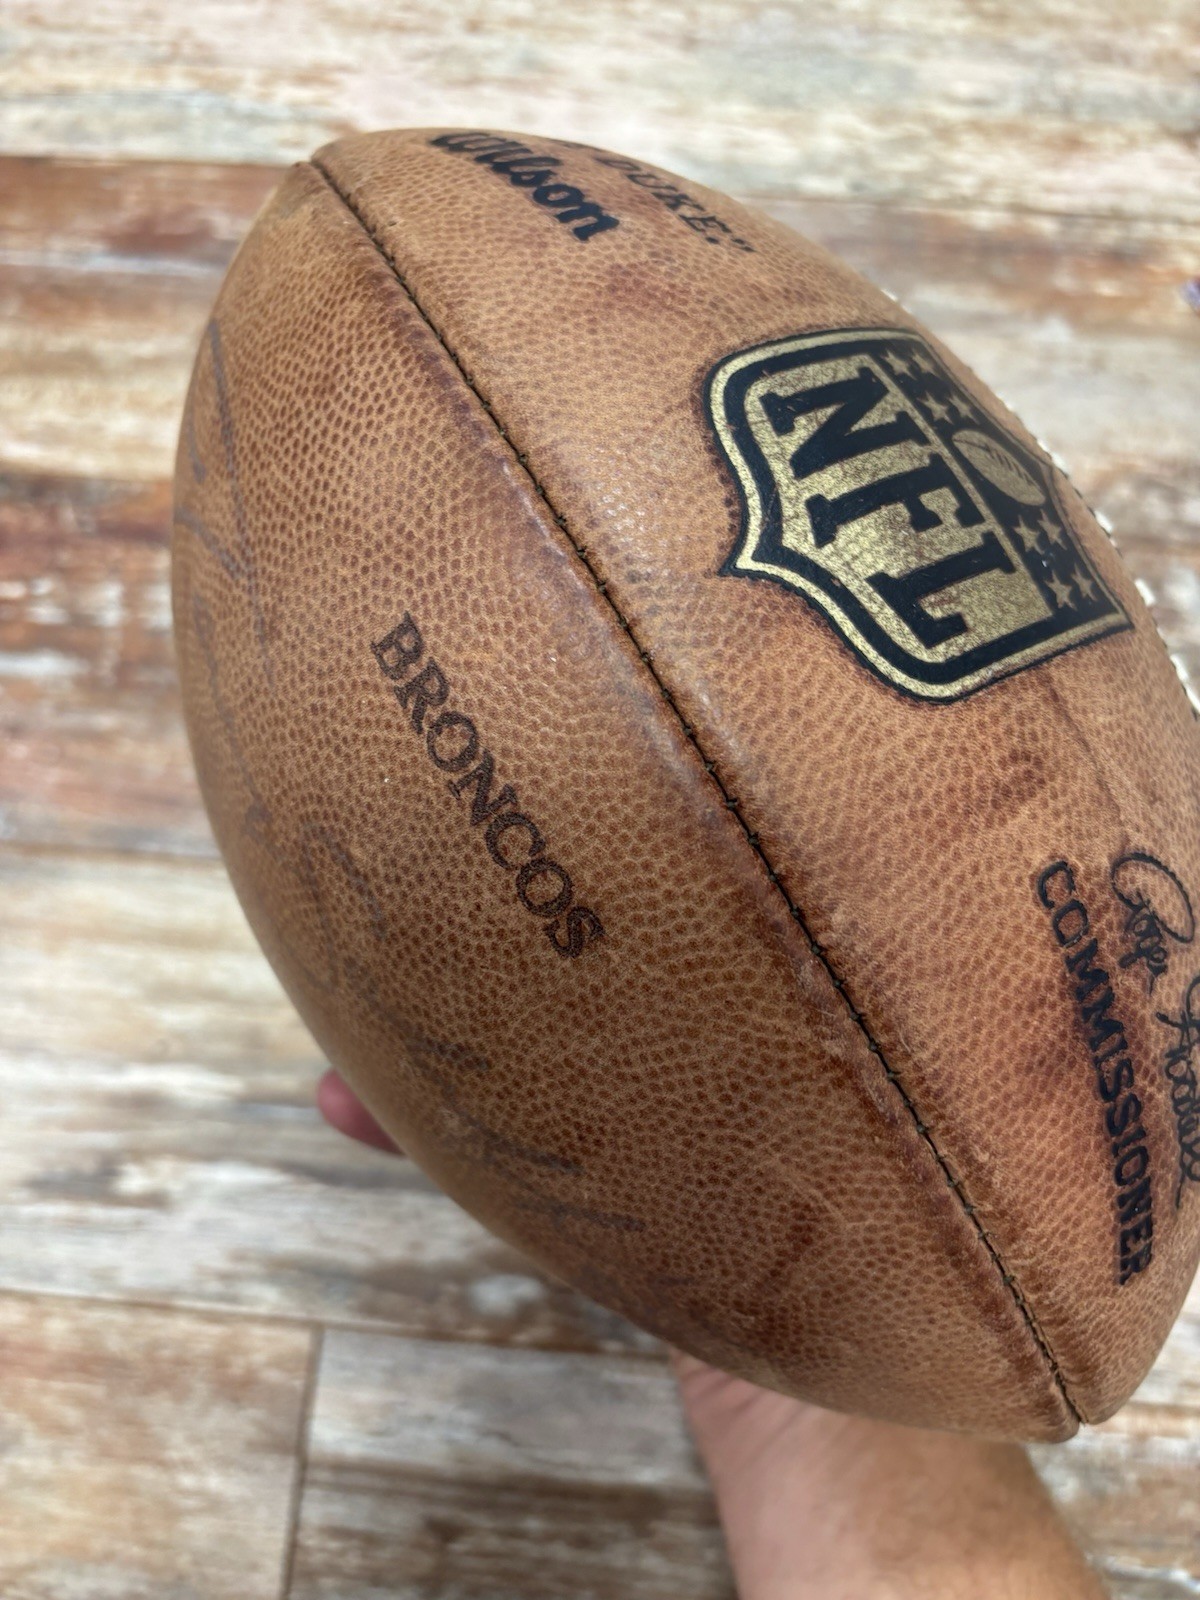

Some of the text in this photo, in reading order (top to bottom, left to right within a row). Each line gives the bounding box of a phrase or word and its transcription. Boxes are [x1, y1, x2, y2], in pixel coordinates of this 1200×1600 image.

[430, 132, 620, 242] Wilson
[759, 366, 1016, 649] NFL
[371, 610, 605, 958] BRONCOS
[1037, 861, 1154, 1286] COMMISSIONER
